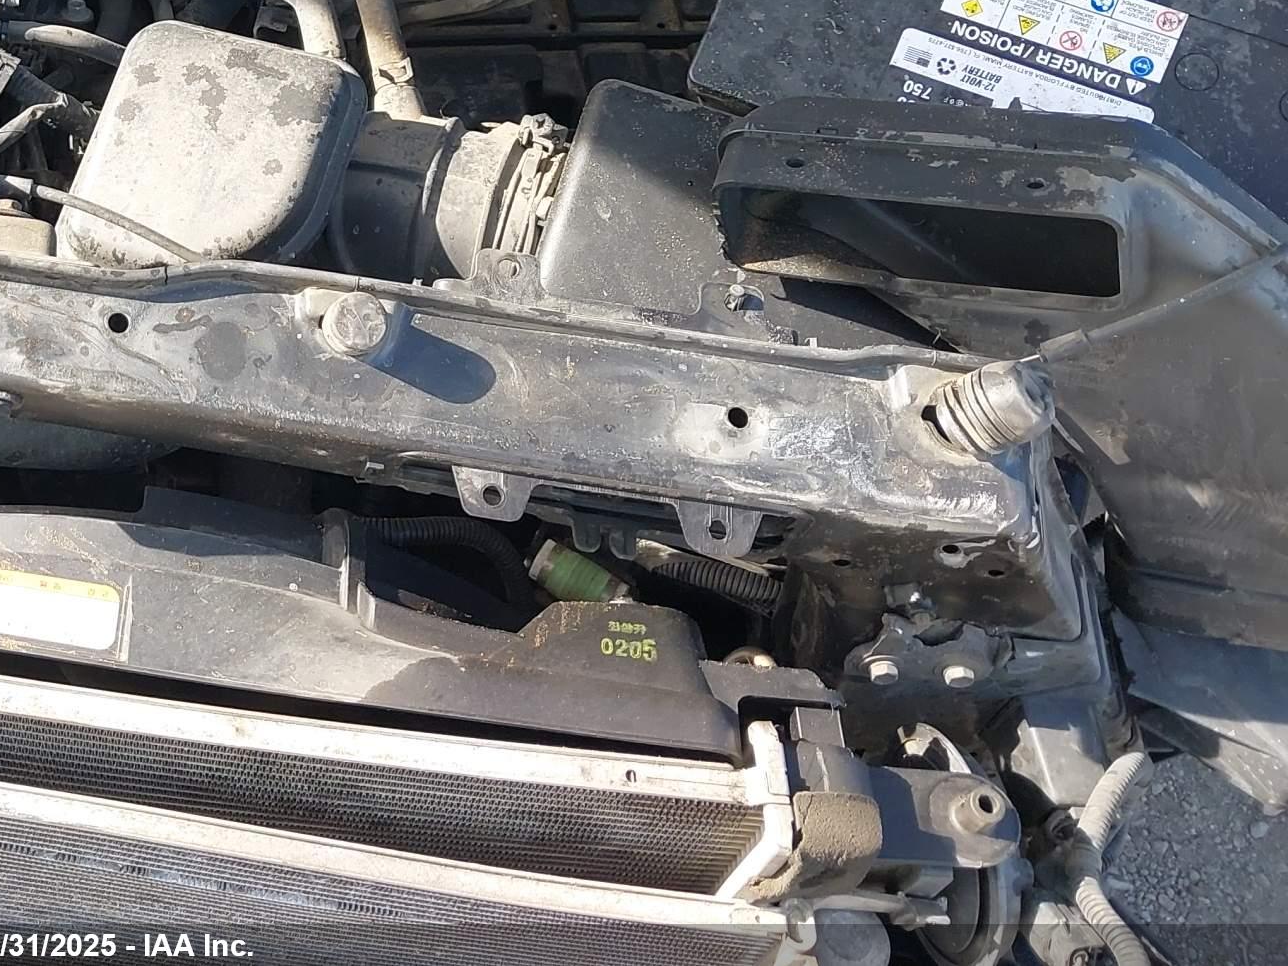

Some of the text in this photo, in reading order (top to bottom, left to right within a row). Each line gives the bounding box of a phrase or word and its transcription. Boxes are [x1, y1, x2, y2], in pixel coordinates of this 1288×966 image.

[960, 63, 1002, 84] BATTERY
[1001, 61, 1034, 77] BATTERY
[1033, 47, 1122, 89] DANGER
[903, 80, 933, 100] 750
[959, 73, 996, 93] 12-VOLT
[1033, 72, 1064, 88] FLORIDA
[1074, 86, 1121, 107] DISTRIBUTED
[601, 638, 658, 662] 0205
